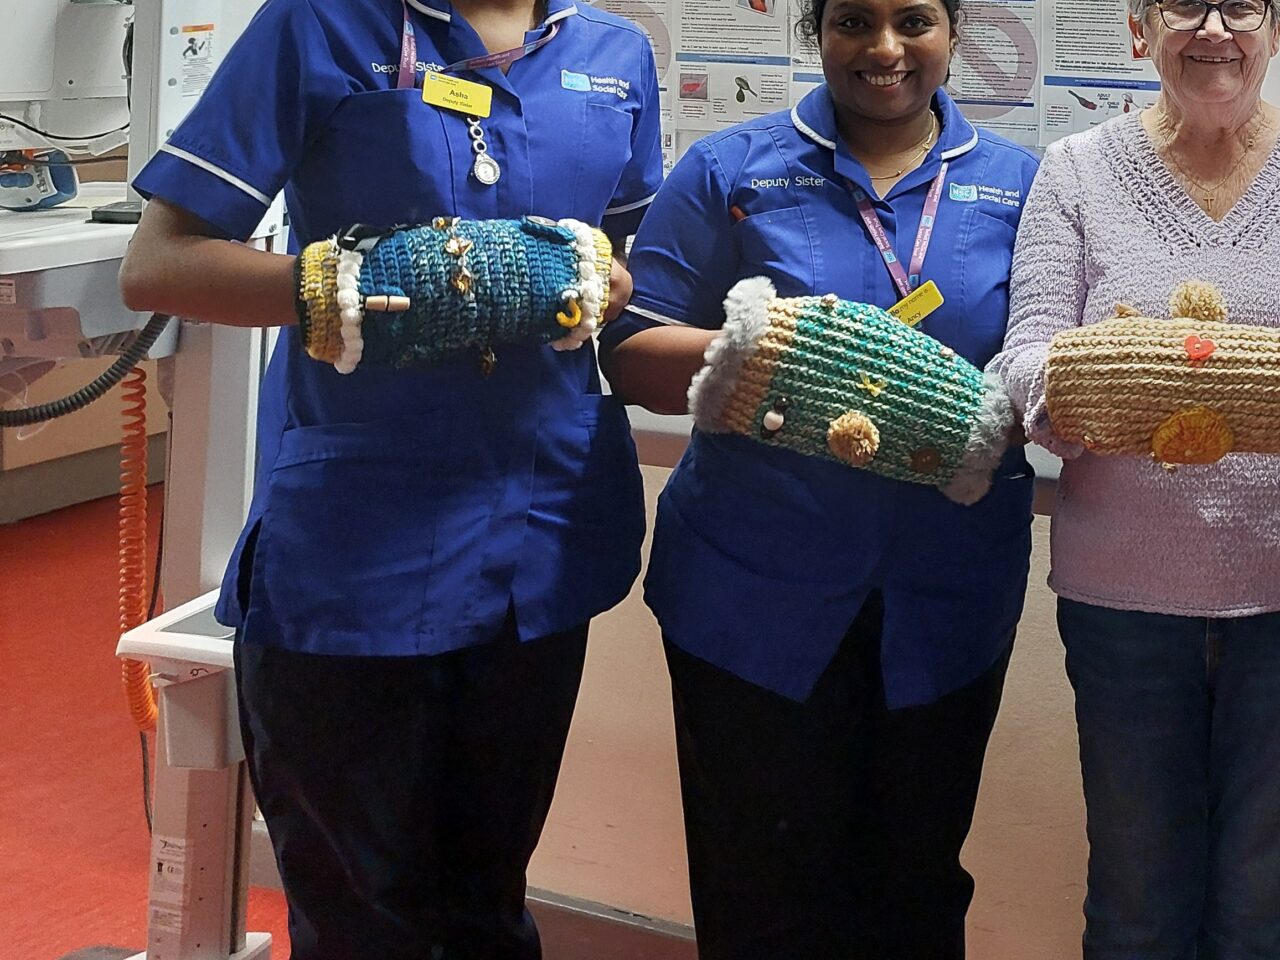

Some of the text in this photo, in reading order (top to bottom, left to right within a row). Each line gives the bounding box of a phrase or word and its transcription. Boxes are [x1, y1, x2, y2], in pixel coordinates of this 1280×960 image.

[371, 61, 445, 75] Depu Siste
[449, 89, 469, 100] Asha
[751, 176, 826, 190] Deputy Sister
[978, 185, 1020, 198] Health and
[979, 193, 1020, 208] Social Care
[907, 311, 922, 324] Ancy
